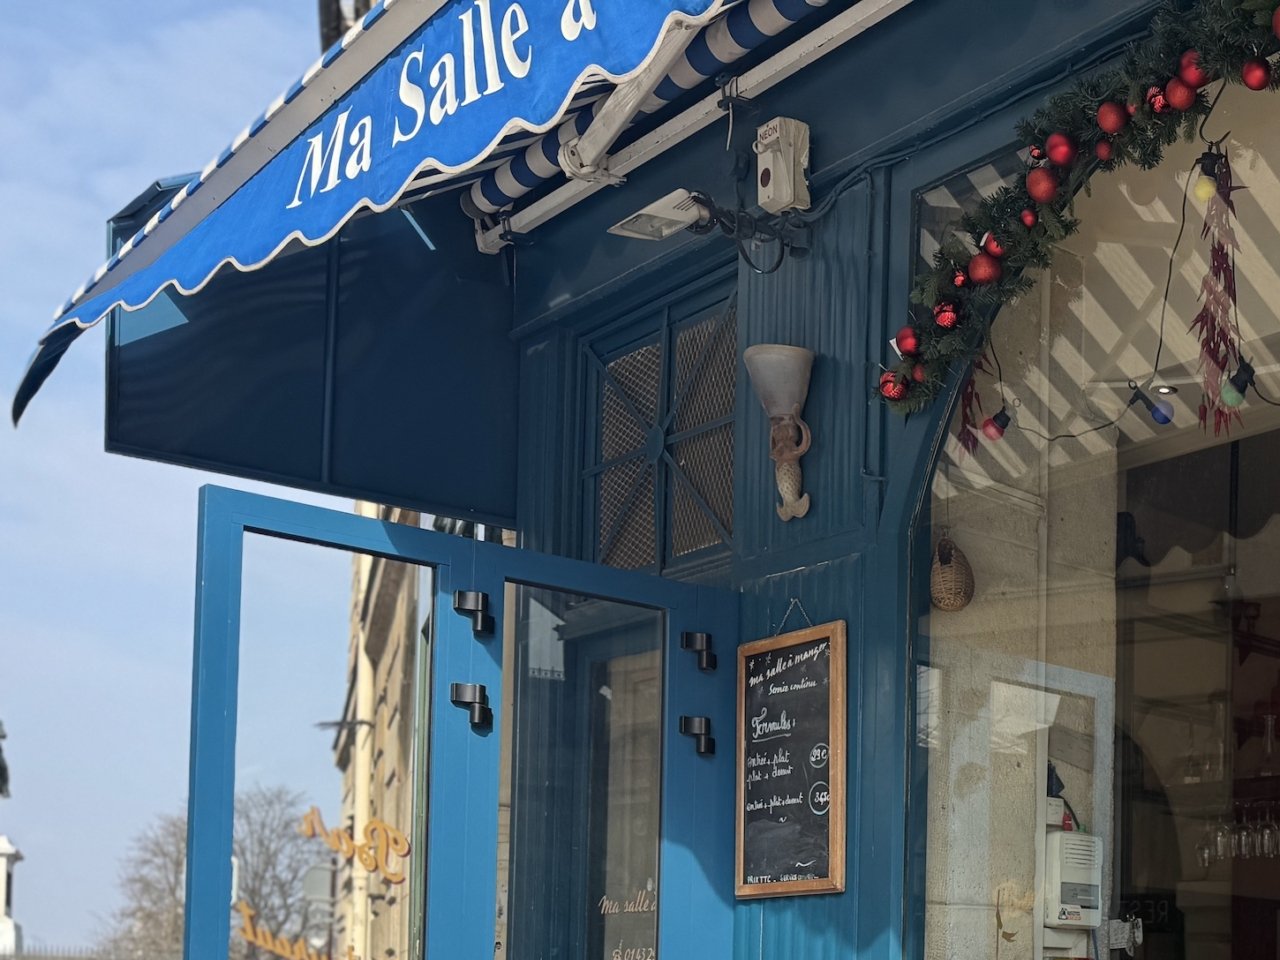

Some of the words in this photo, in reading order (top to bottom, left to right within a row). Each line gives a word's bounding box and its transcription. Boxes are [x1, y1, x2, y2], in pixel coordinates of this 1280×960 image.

[286, 104, 372, 209] Ma
[392, 0, 532, 148] Salle
[765, 657, 787, 680] salle
[794, 642, 827, 664] manger
[598, 895, 620, 914] Ma
[624, 889, 649, 912] salle
